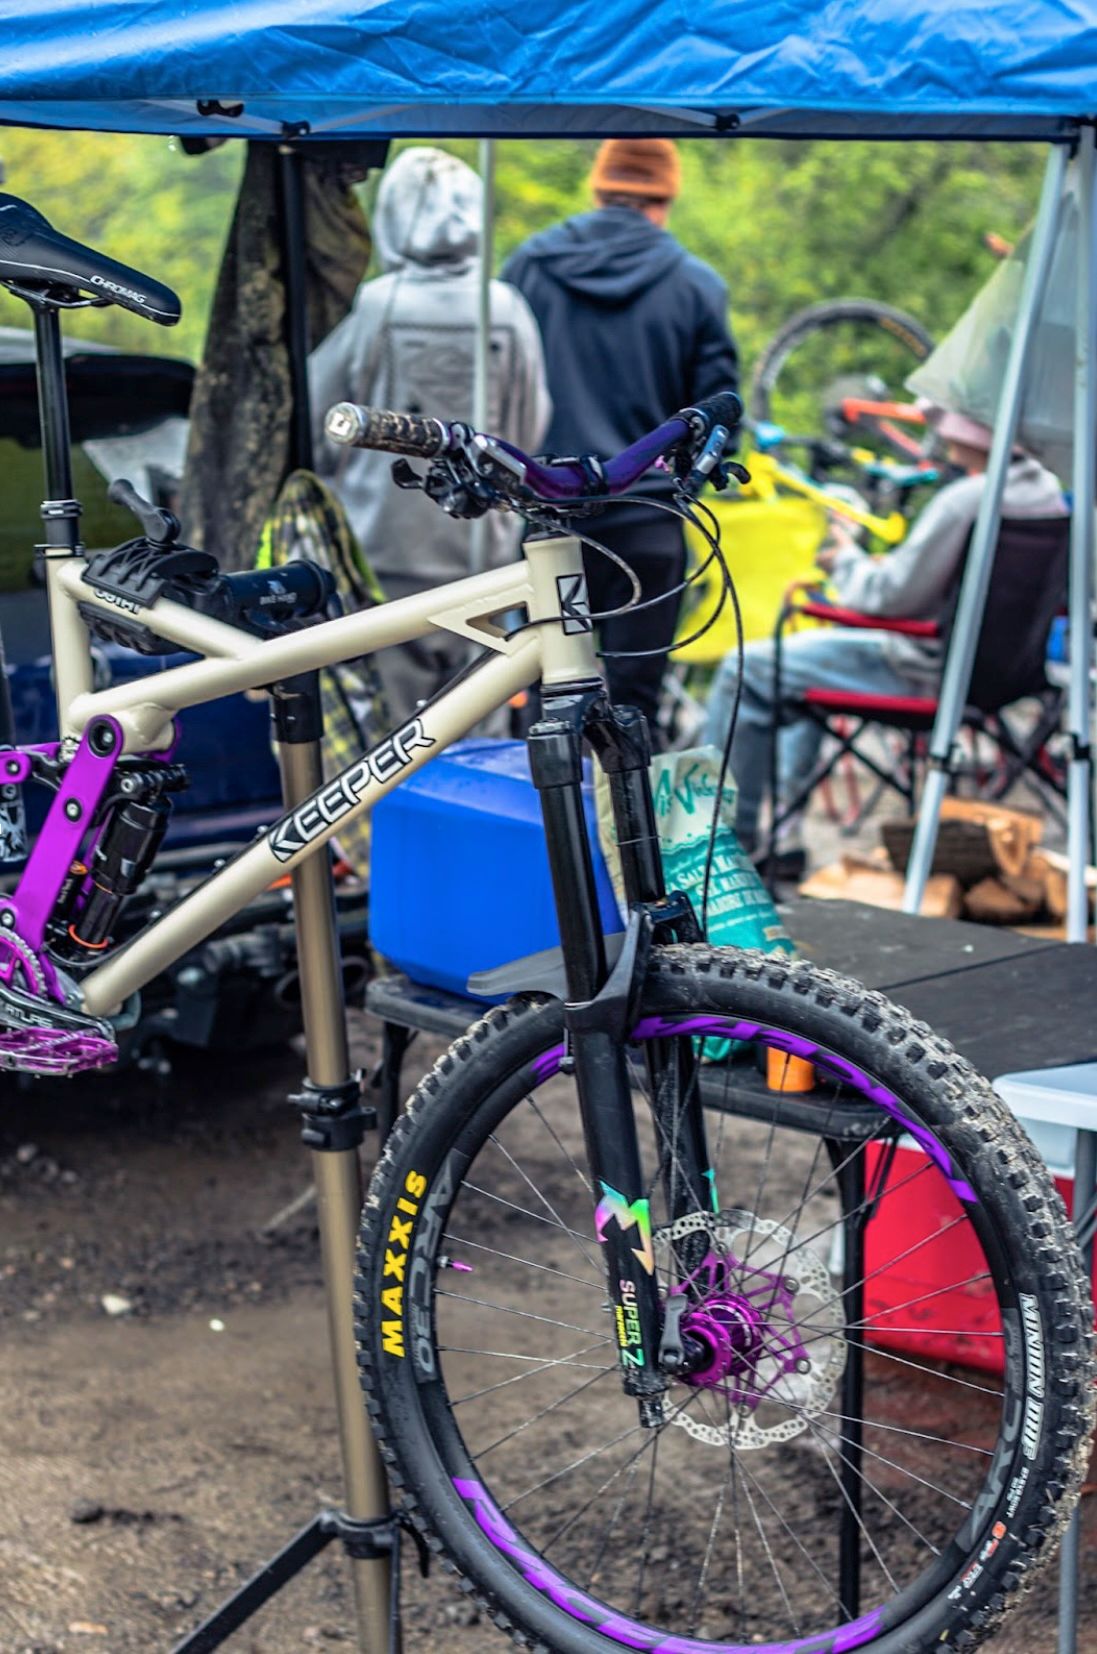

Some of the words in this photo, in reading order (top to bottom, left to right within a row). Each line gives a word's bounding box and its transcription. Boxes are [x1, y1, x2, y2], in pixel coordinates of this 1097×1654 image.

[90, 275, 147, 304] CHROMAG
[267, 718, 437, 864] KEEPER
[381, 1170, 427, 1358] MAXXIS
[620, 1279, 642, 1345] SUPER
[1019, 1293, 1045, 1399] MINION
[621, 1348, 645, 1367] Z
